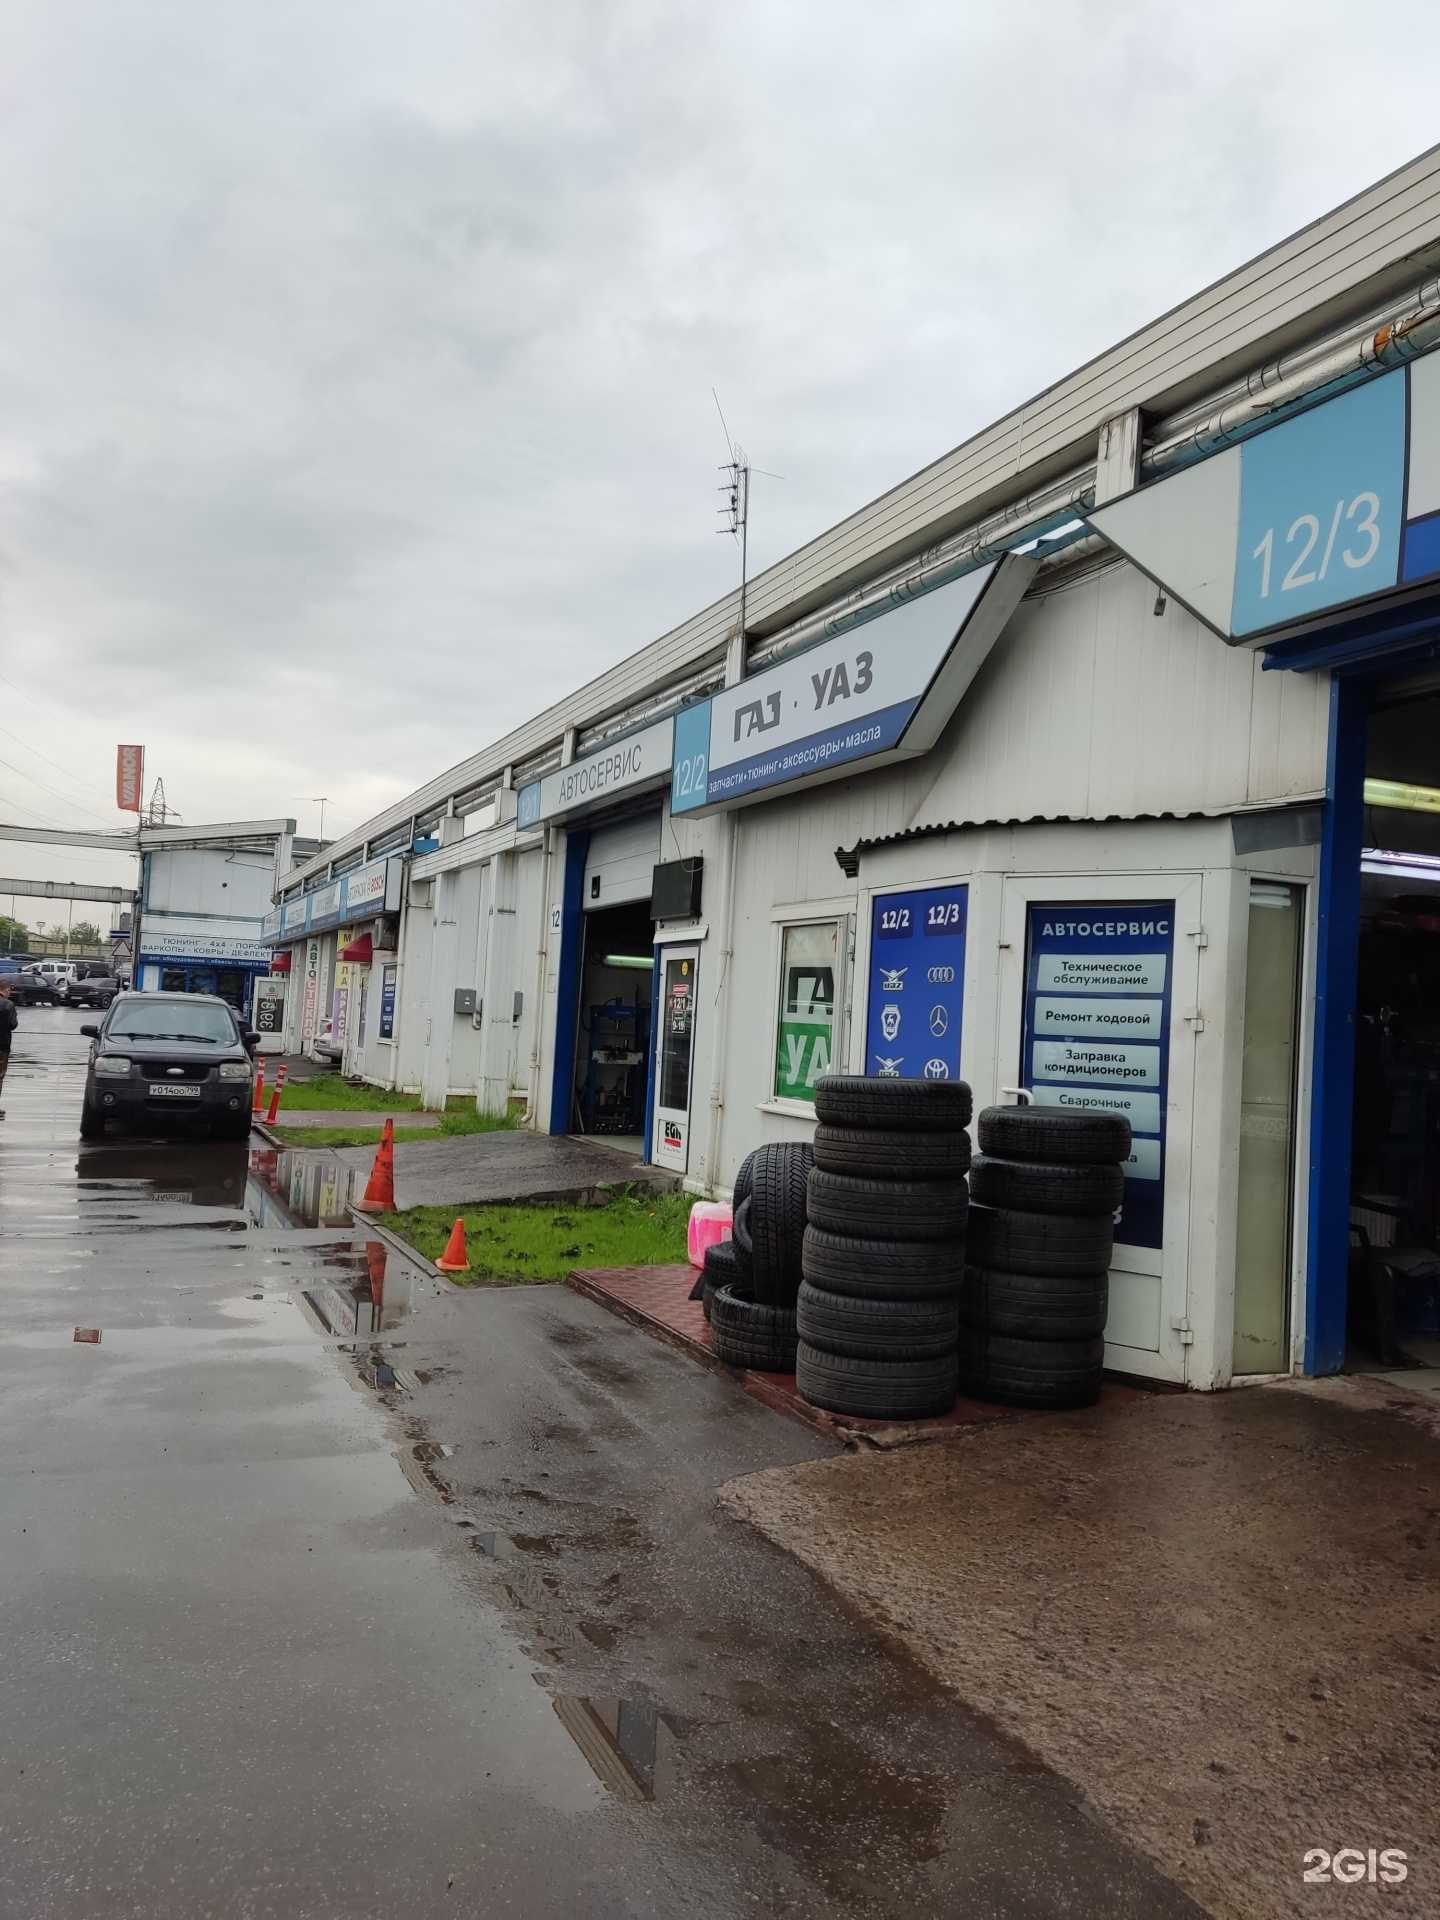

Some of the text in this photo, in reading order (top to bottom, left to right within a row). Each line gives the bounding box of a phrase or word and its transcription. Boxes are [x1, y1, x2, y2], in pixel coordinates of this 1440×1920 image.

[1253, 492, 1381, 598] 12/3
[733, 651, 874, 742] ГАЗ УАЗ
[709, 725, 881, 793] запчасти тюнинг аксессуары масла
[558, 744, 642, 802] АВТОСЕРВИС
[674, 754, 706, 797] 12/2
[551, 910, 561, 929] 12
[881, 909, 910, 929] 12/2
[928, 905, 960, 925] 12/3
[1042, 920, 1169, 937] АВТОСЕРВИС
[141, 944, 185, 953] ФАРКОПЫ
[193, 947, 225, 956] КОВРЫ
[162, 937, 200, 946] ТЮНИНГ
[1061, 961, 1143, 973] Техническое
[1053, 974, 1149, 986] обслуживание
[1045, 1011, 1151, 1025] Ремонт ходовой
[1065, 1049, 1126, 1063] Заправка
[1045, 1063, 1147, 1078] кондиционеров
[1059, 1094, 1132, 1109] Сварочные
